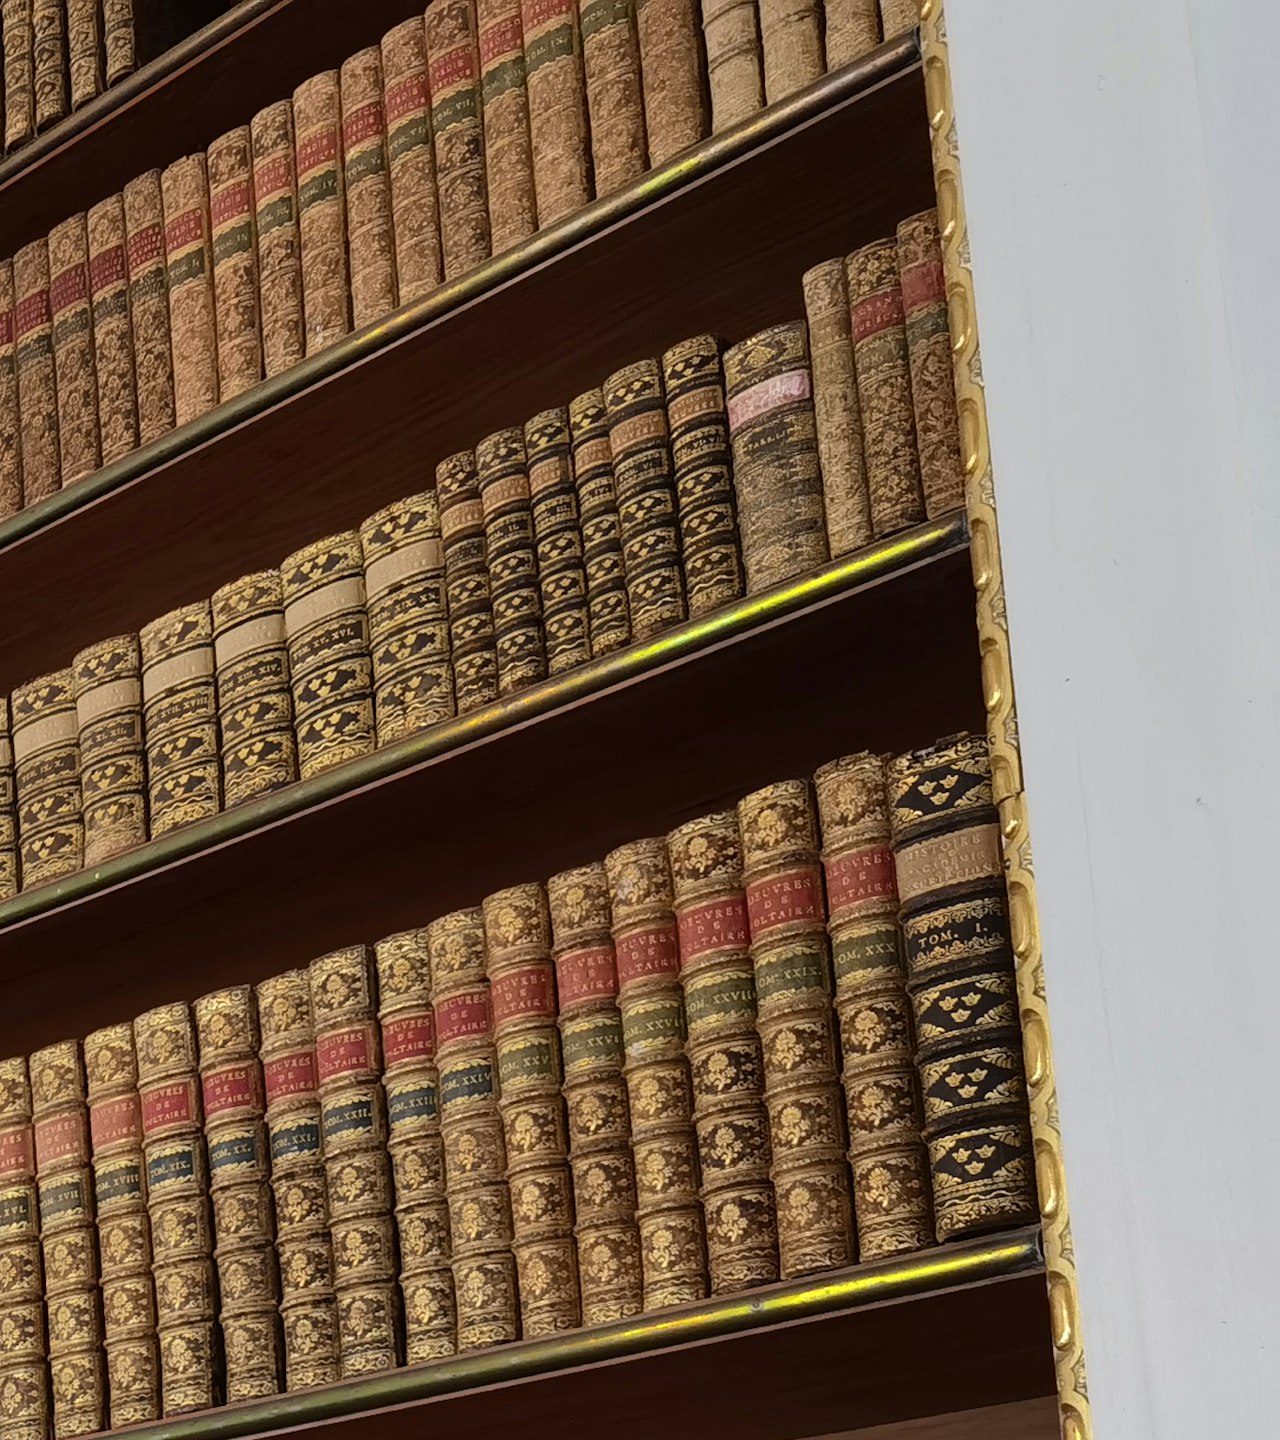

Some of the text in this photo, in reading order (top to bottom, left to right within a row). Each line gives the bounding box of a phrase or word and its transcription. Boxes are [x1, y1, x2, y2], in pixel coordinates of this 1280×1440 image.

[842, 871, 867, 886] DE
[764, 895, 789, 909] DE
[697, 921, 721, 934] DE
[918, 922, 988, 949] TOM. I.
[758, 973, 779, 988] OM.
[625, 1025, 642, 1038] OM.
[502, 1062, 518, 1074] OM.
